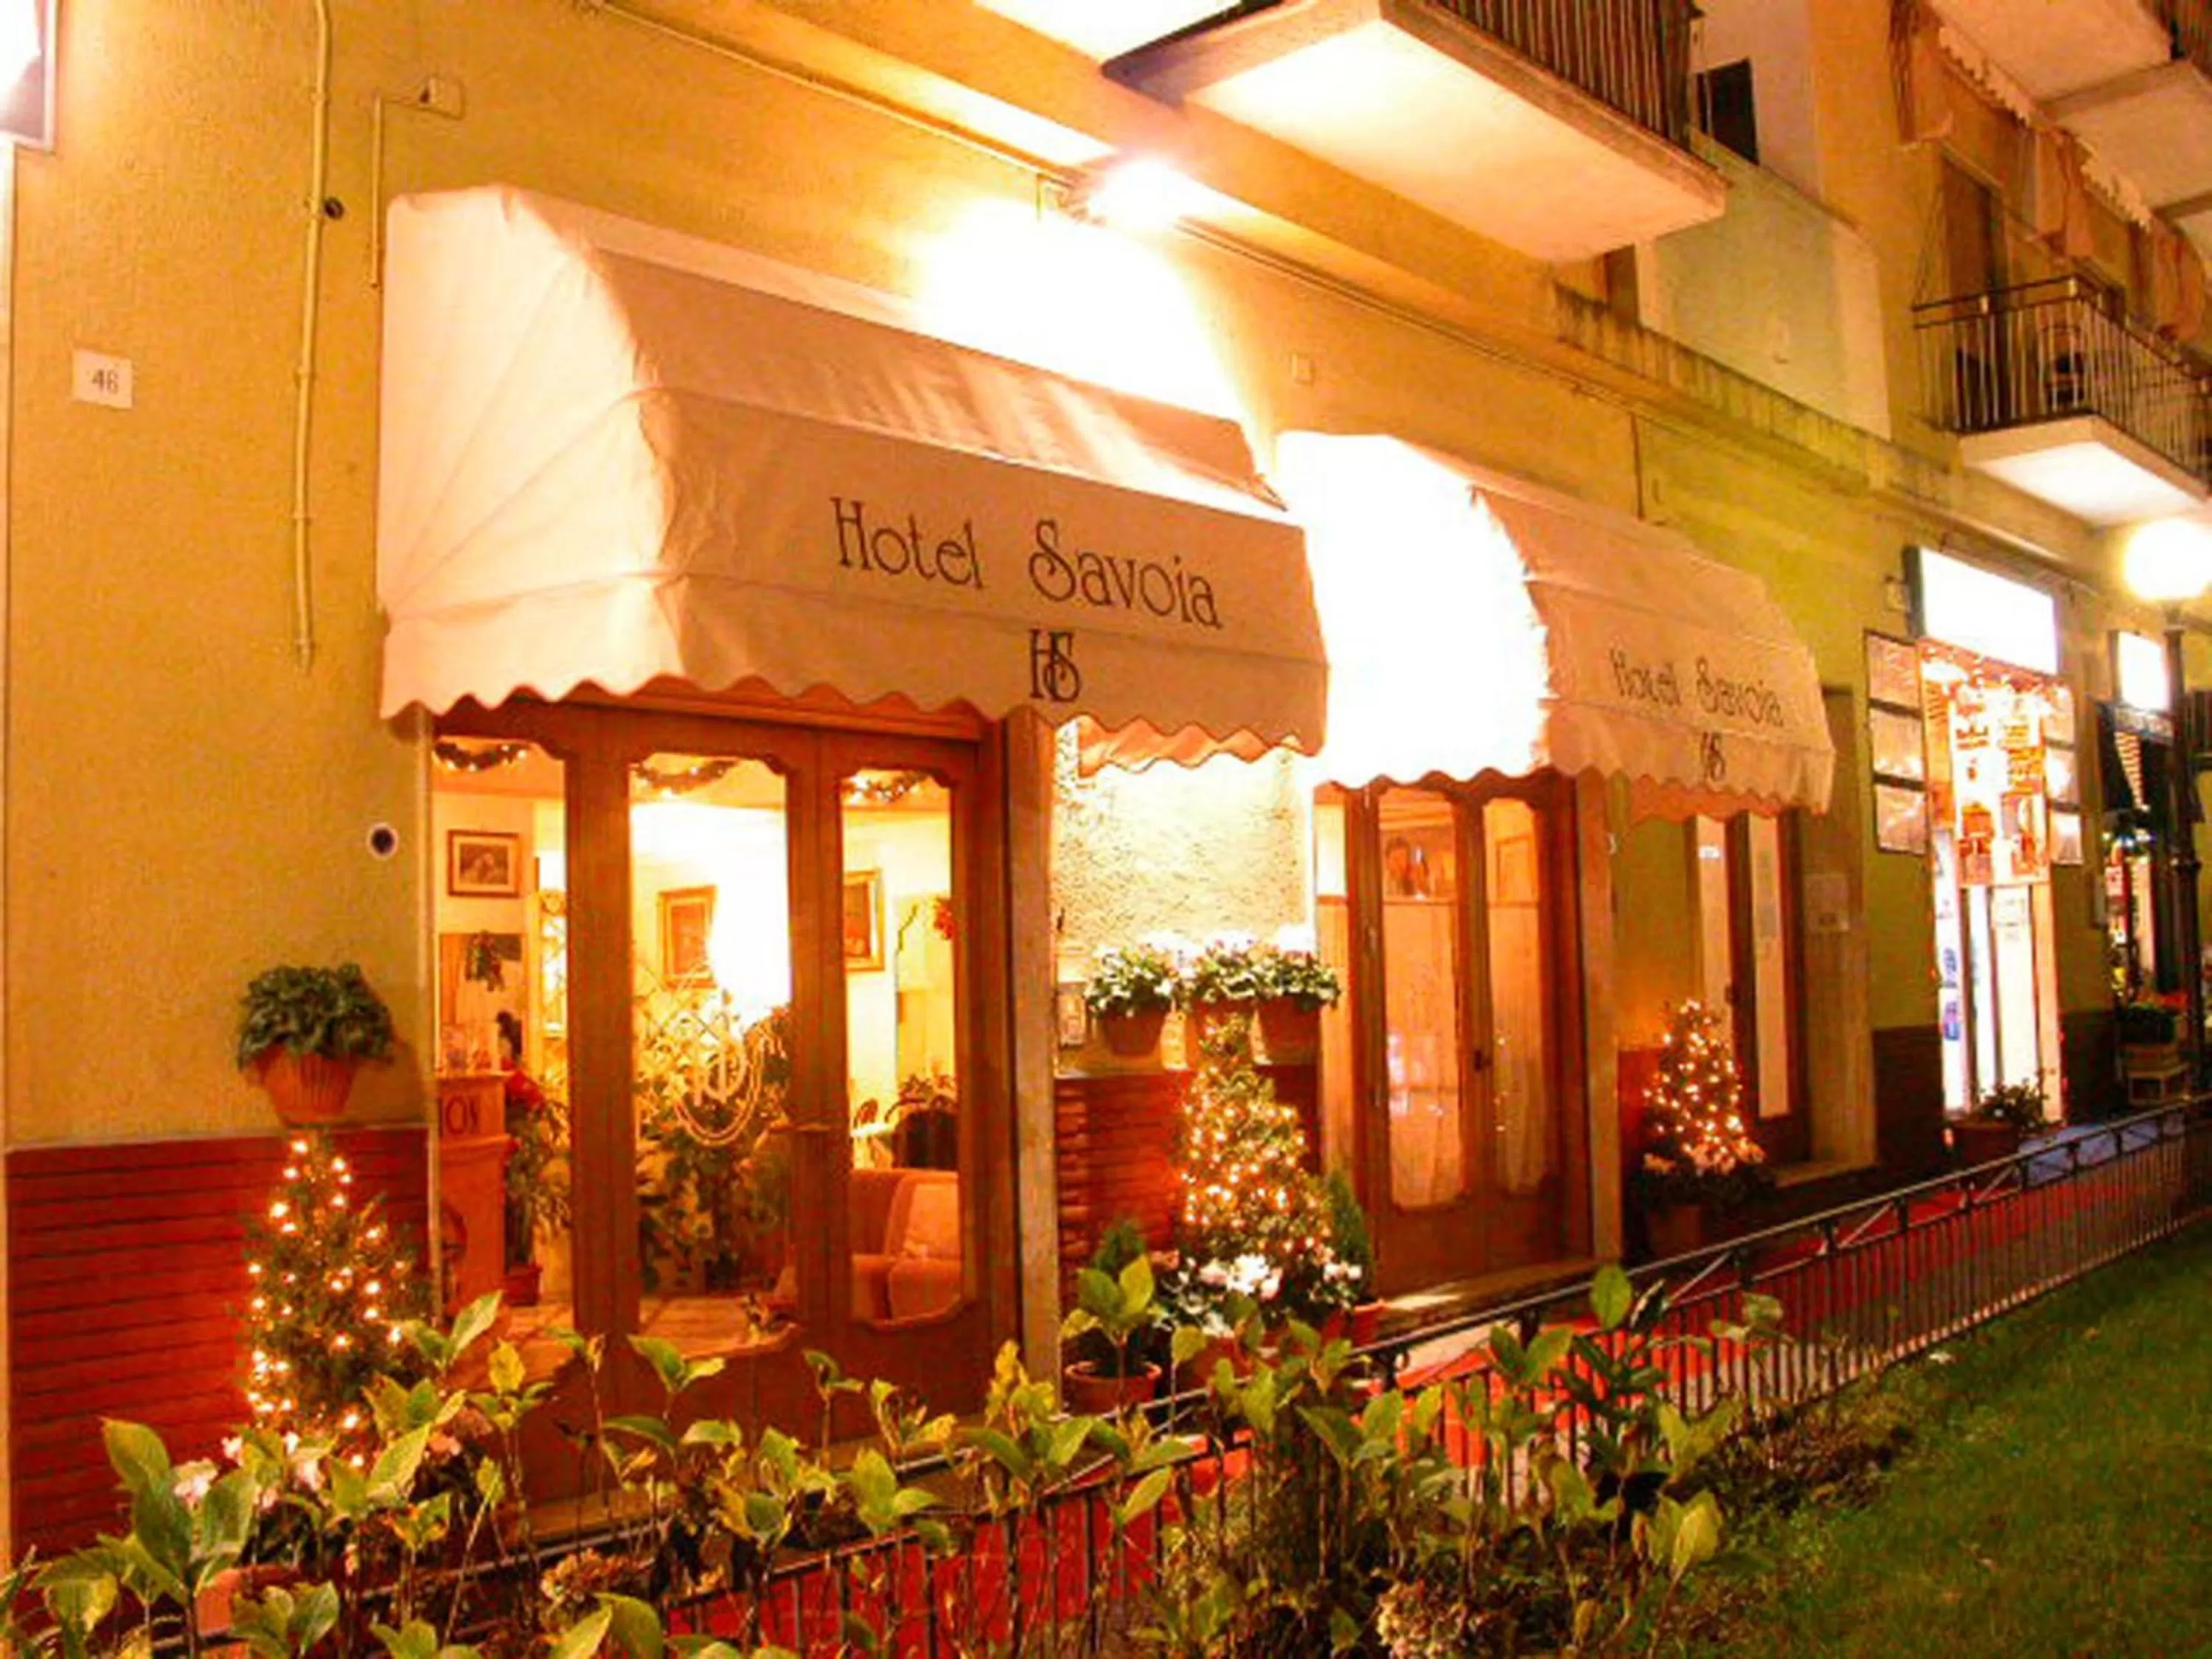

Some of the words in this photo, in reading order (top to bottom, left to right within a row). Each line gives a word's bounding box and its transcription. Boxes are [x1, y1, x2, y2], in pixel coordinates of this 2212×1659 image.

[830, 496, 984, 590] Hotel
[1028, 519, 1223, 630] Savoia
[1609, 647, 1682, 707] Hotel
[1696, 655, 1784, 728] Savoia
